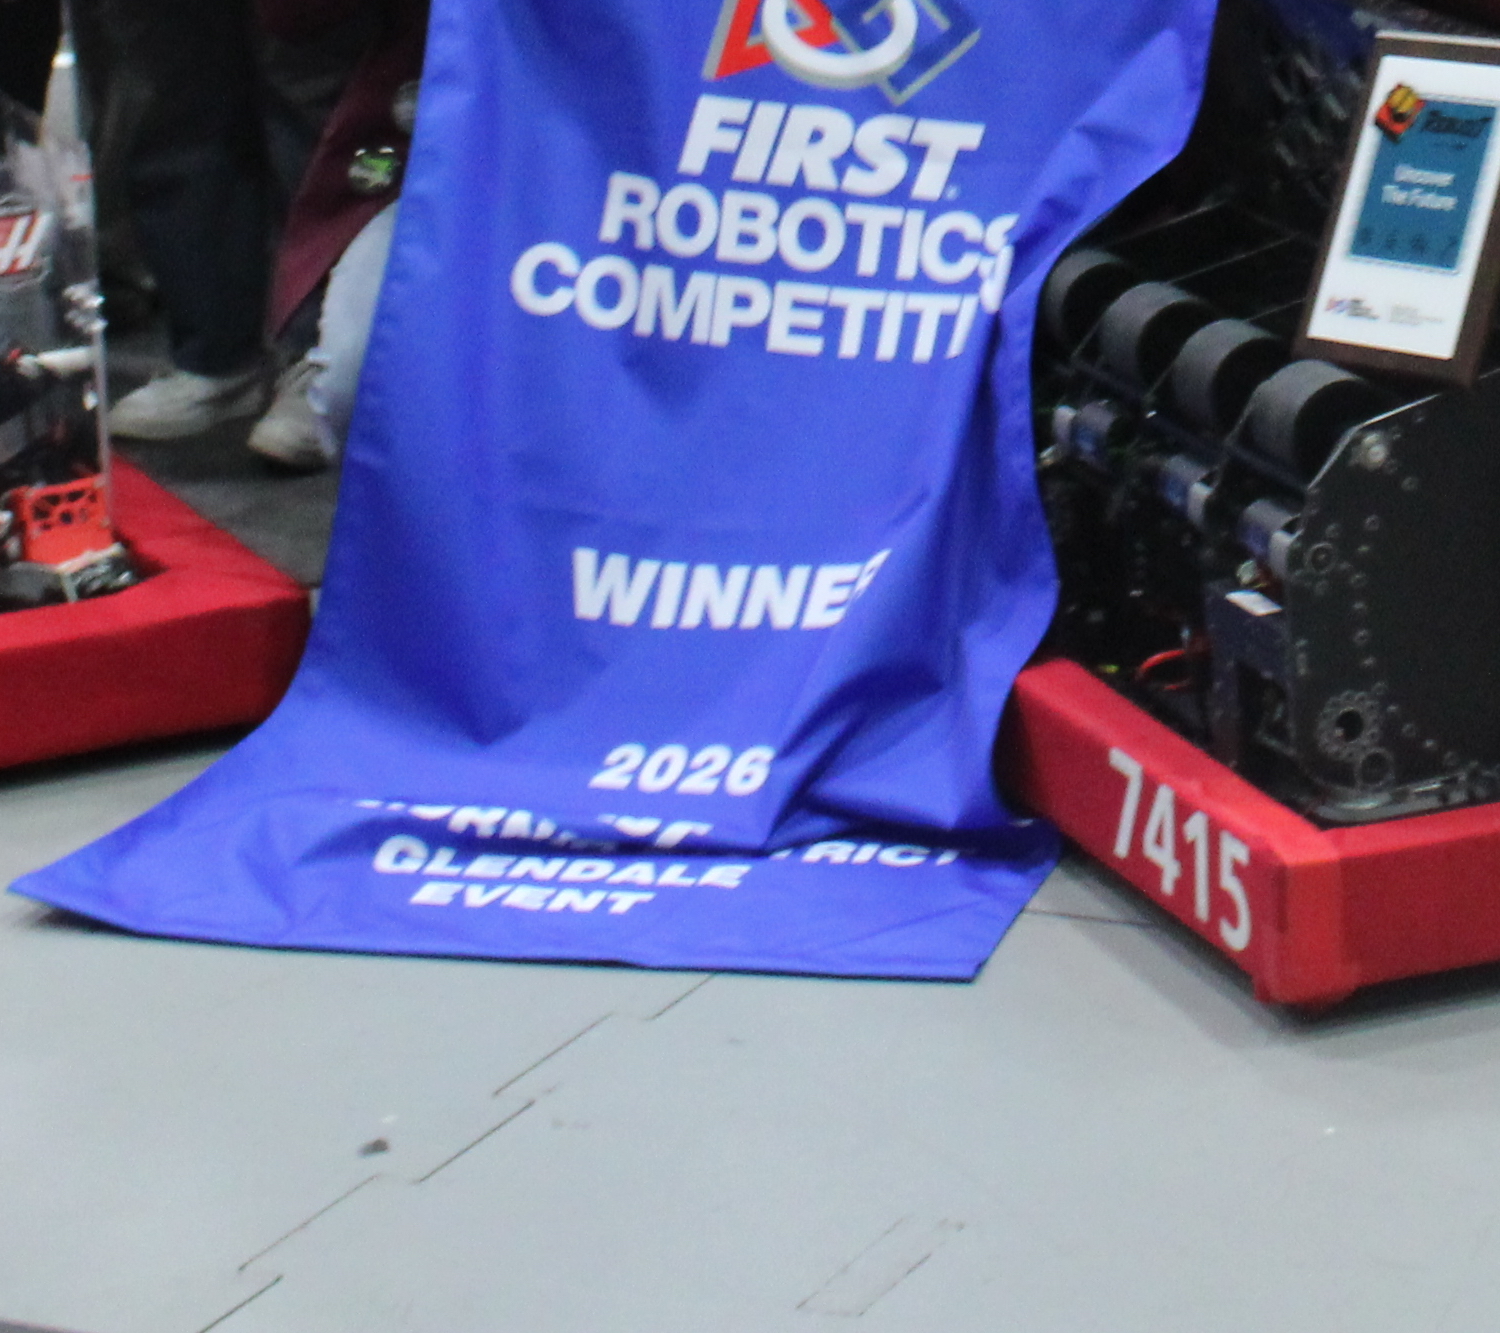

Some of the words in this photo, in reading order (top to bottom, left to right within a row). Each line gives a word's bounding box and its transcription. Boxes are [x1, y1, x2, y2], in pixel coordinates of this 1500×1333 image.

[678, 93, 985, 202] FIRST
[599, 170, 1019, 287] ROBOTICS
[510, 241, 982, 365] COMPETITI
[588, 741, 777, 797] 2026
[373, 834, 753, 888] GLENDALE
[408, 881, 657, 915] EVENT
[1108, 747, 1252, 953] 7415
